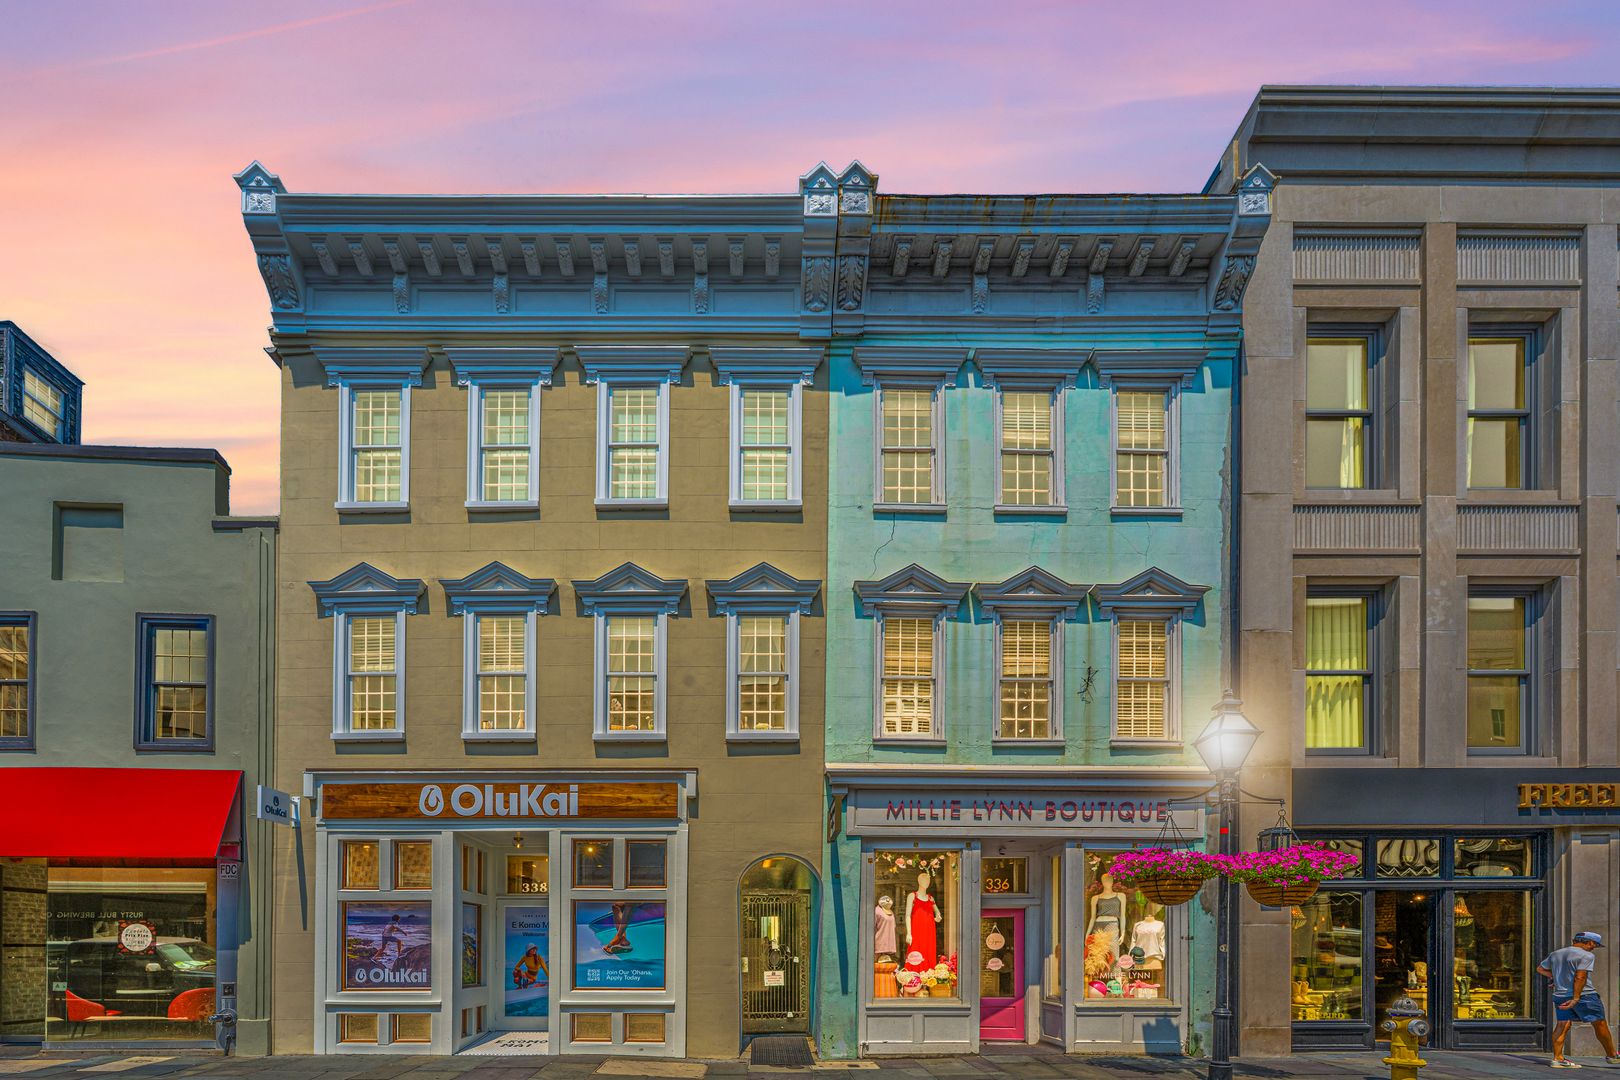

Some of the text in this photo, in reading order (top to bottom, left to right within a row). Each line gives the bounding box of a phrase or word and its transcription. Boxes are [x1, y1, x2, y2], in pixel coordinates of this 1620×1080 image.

[451, 784, 578, 816] OluKai
[1517, 783, 1620, 808] FREE
[265, 804, 287, 818] OluKai
[886, 801, 1168, 823] MILLIE LYNN BOUTIQUE
[220, 864, 237, 875] FDC
[522, 882, 548, 893] 338
[985, 878, 1010, 890] 336
[511, 921, 518, 929] E
[519, 921, 541, 929] Komo
[369, 968, 427, 983] OluKai
[1128, 971, 1151, 979] LYNN
